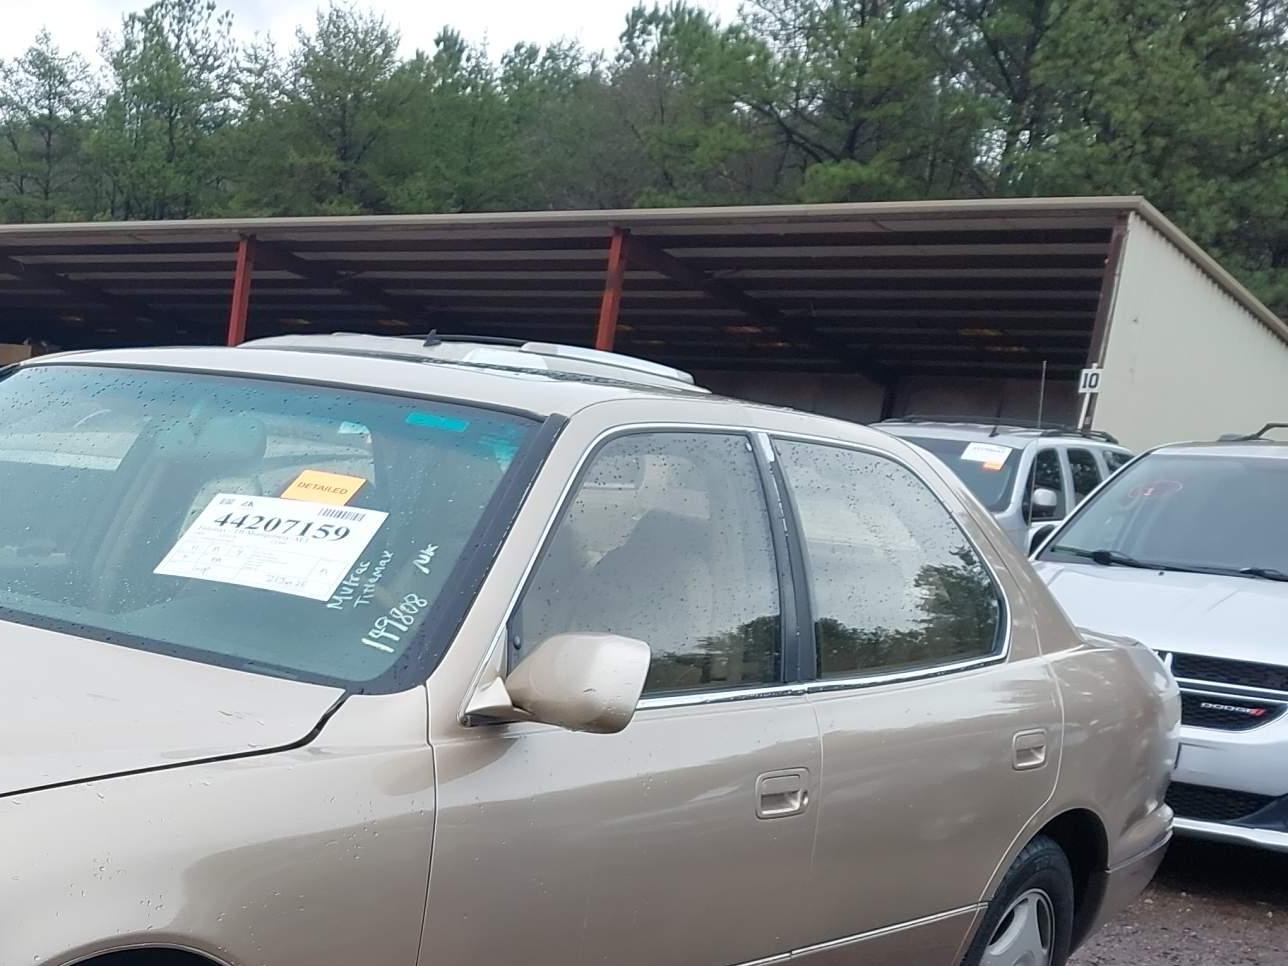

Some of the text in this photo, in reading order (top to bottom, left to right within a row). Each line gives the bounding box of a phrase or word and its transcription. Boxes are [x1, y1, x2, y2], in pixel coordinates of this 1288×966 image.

[1082, 372, 1100, 389] 10
[297, 481, 349, 495] DETAILED
[214, 512, 351, 541] 44207159
[361, 593, 428, 653] 149808
